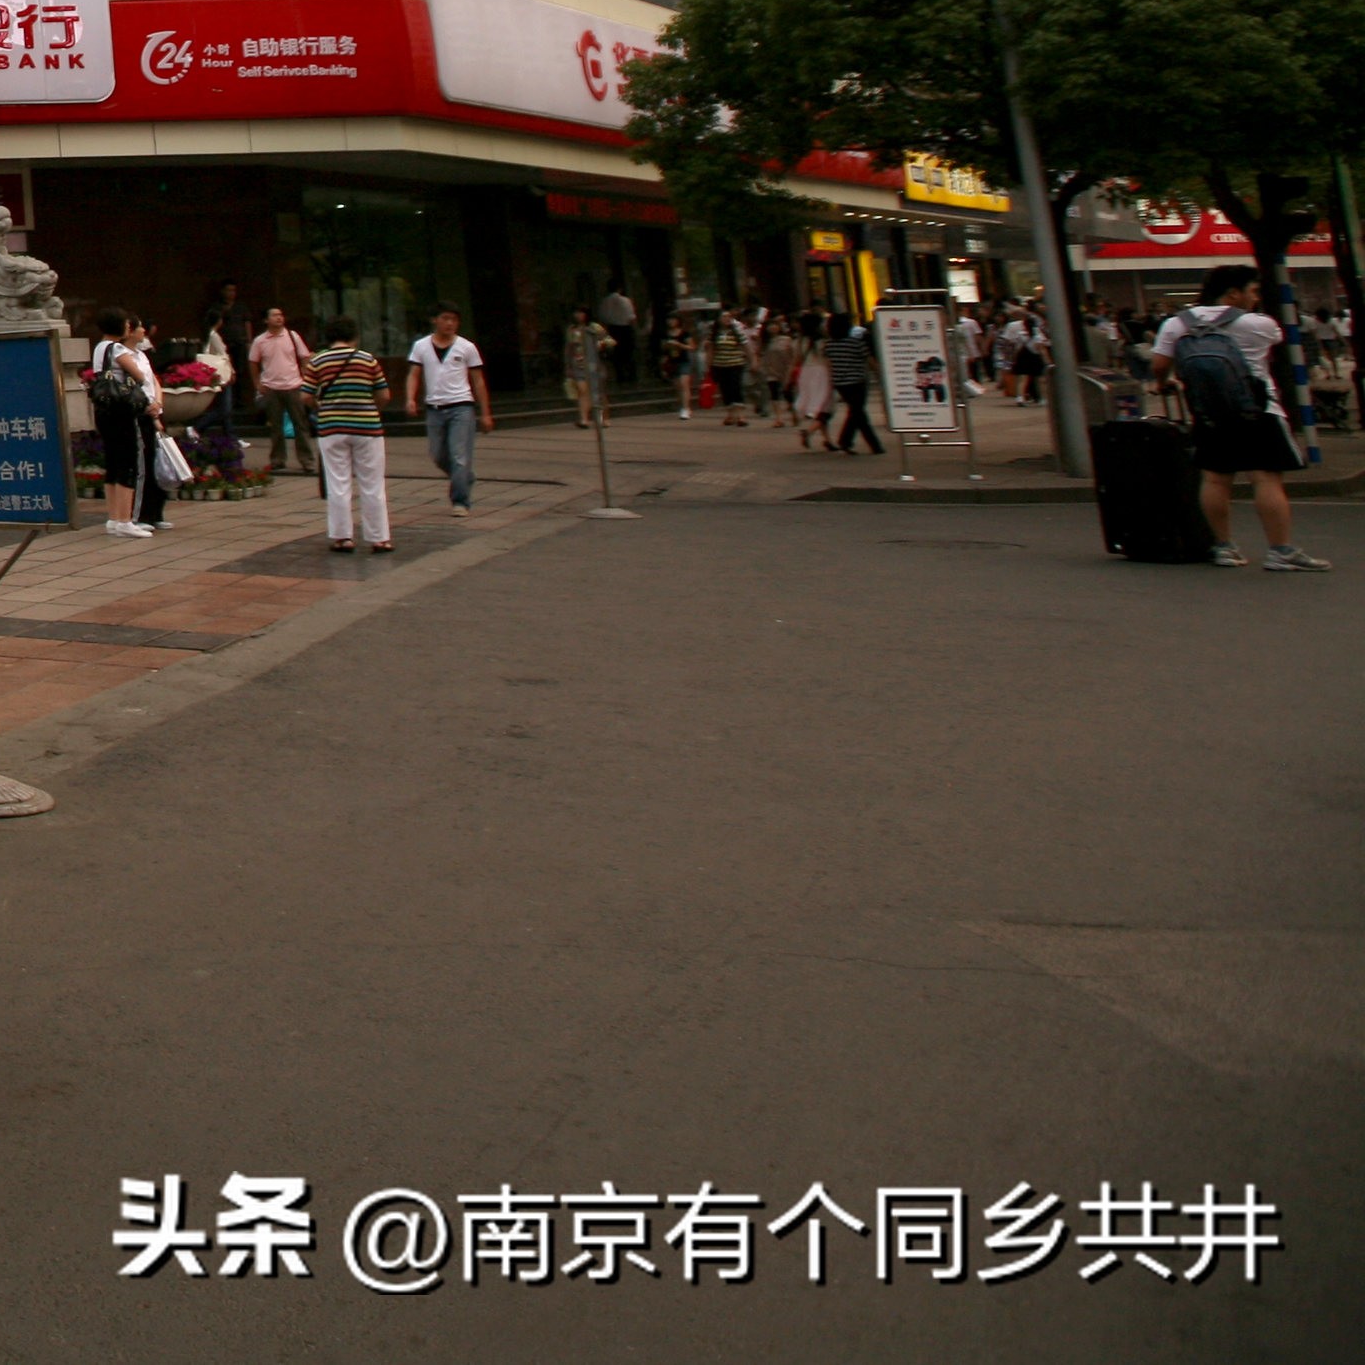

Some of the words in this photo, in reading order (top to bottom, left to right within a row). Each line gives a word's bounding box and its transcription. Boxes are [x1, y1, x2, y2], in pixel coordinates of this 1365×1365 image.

[203, 44, 230, 55] 小时
[242, 36, 358, 58] 自助银行服务
[157, 40, 194, 69] 24
[201, 58, 234, 68] Hour
[237, 66, 263, 78] Self
